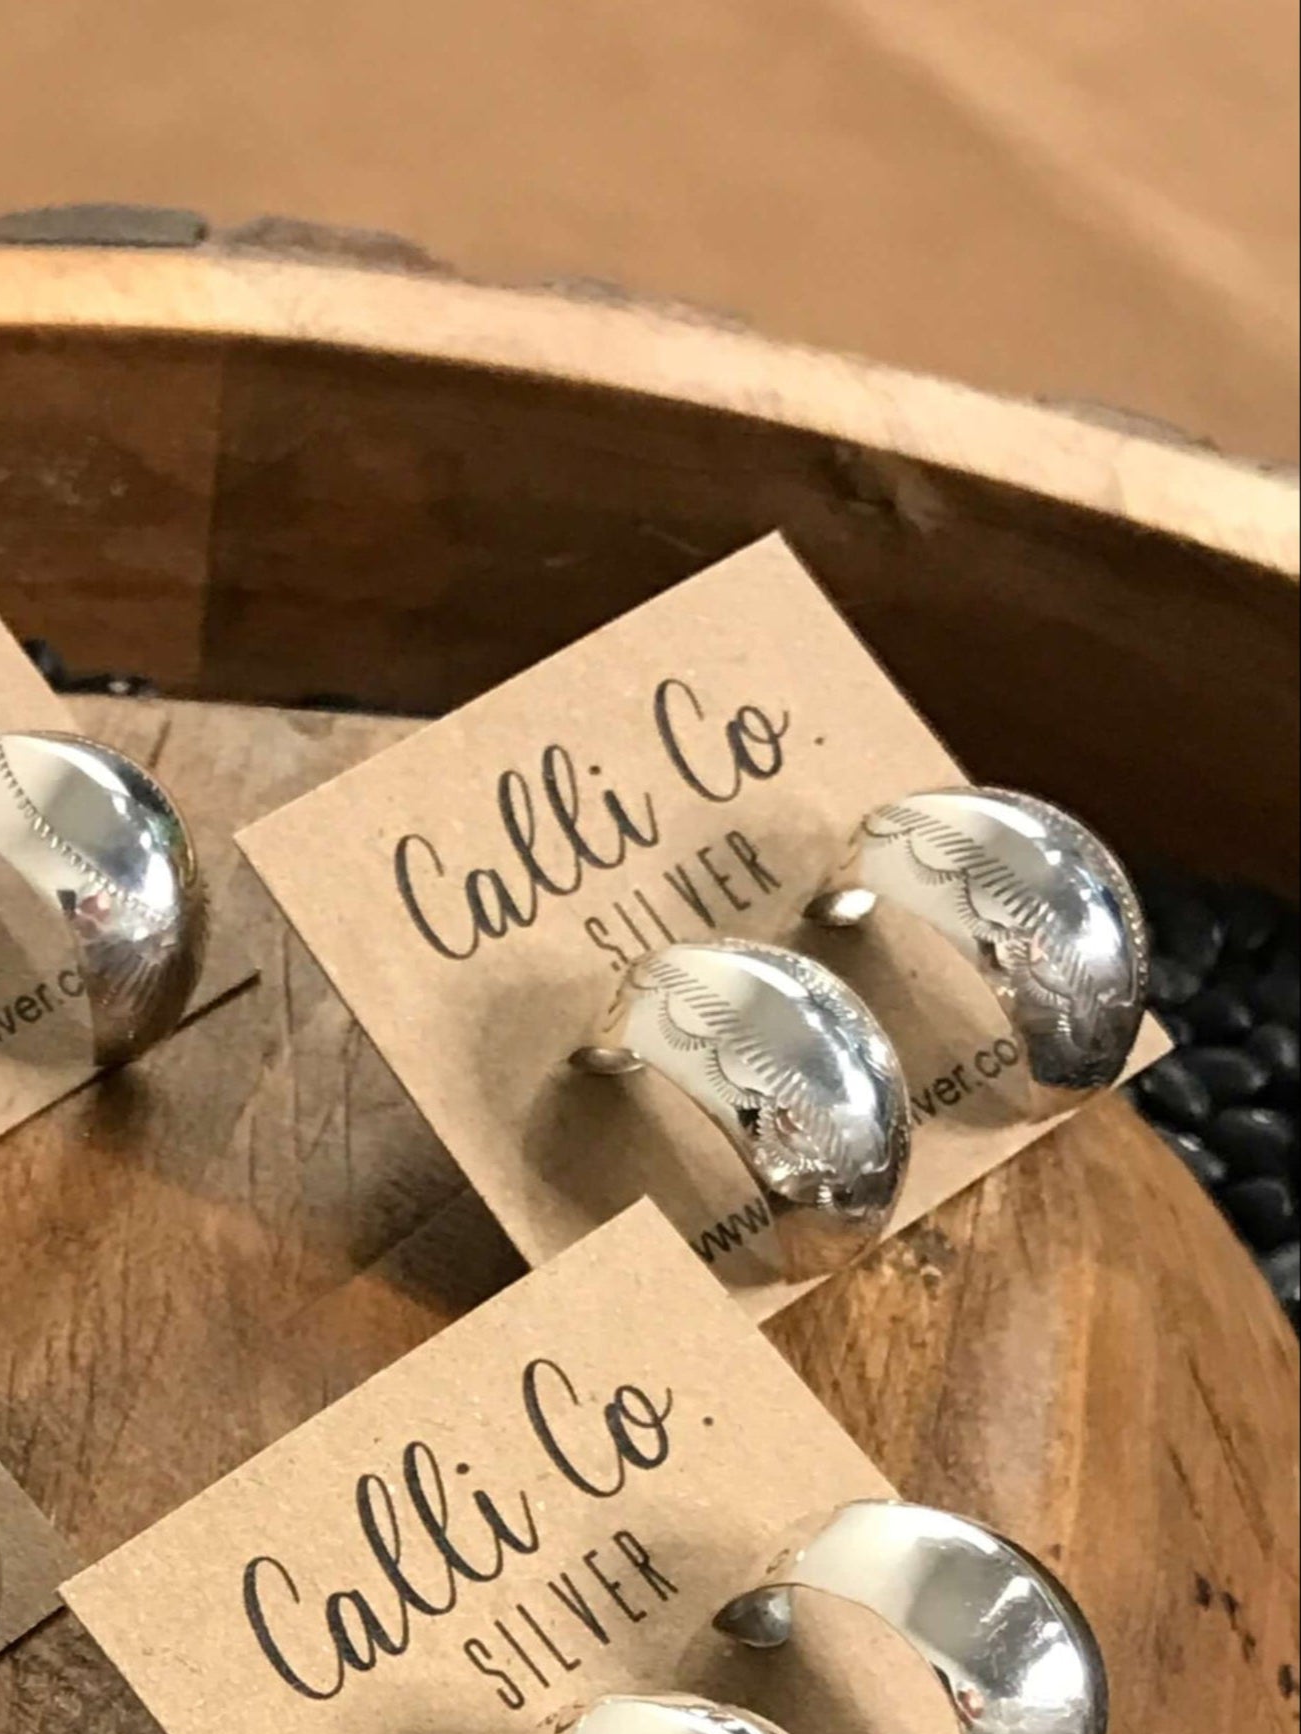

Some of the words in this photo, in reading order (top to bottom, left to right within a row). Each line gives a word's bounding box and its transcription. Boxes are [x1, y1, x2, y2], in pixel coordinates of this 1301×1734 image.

[392, 742, 660, 961] Calli
[241, 1439, 540, 1701] Calli
[462, 1528, 681, 1711] SILVER
